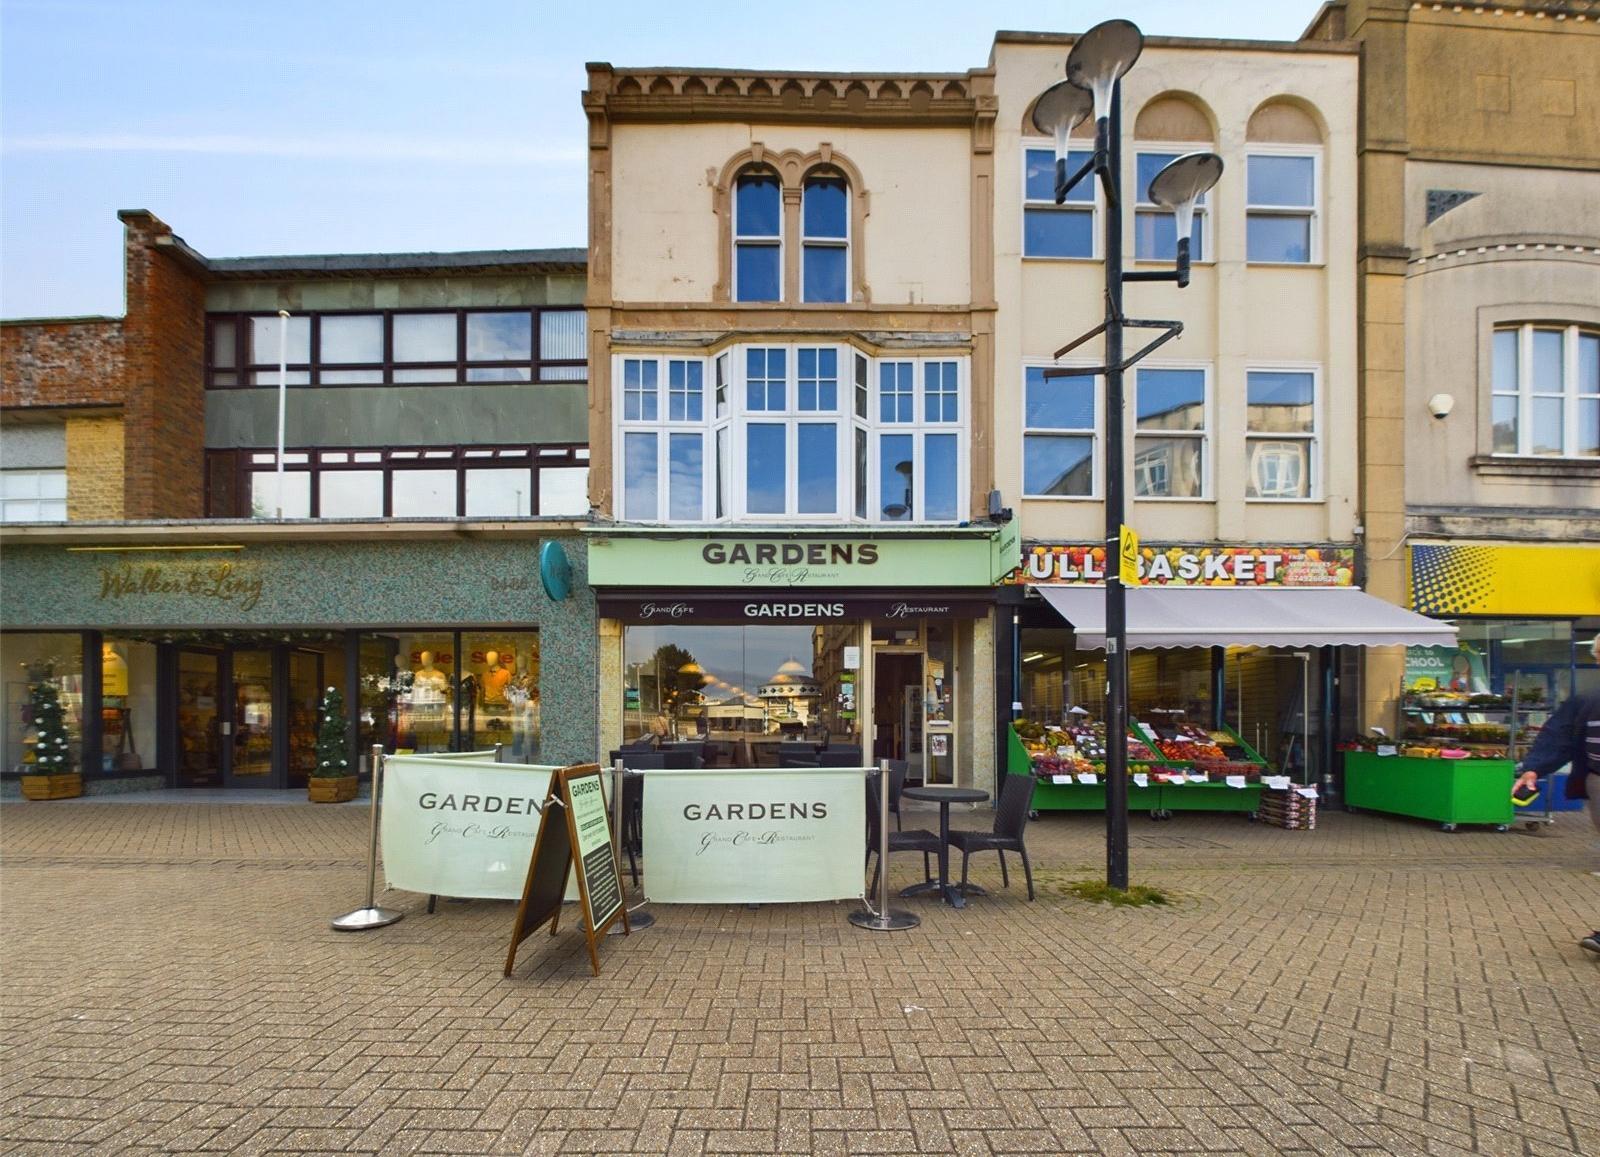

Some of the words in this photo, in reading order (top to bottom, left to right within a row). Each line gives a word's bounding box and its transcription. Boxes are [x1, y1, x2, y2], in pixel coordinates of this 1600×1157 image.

[702, 543, 879, 565] GARDENS
[99, 561, 183, 600] Walker
[203, 562, 263, 612] Ling
[744, 603, 845, 617] GARDENS
[410, 651, 453, 664] Sle
[572, 780, 600, 797] GARDENS
[418, 793, 546, 815] GARDEN
[683, 802, 827, 821] GARDENS
